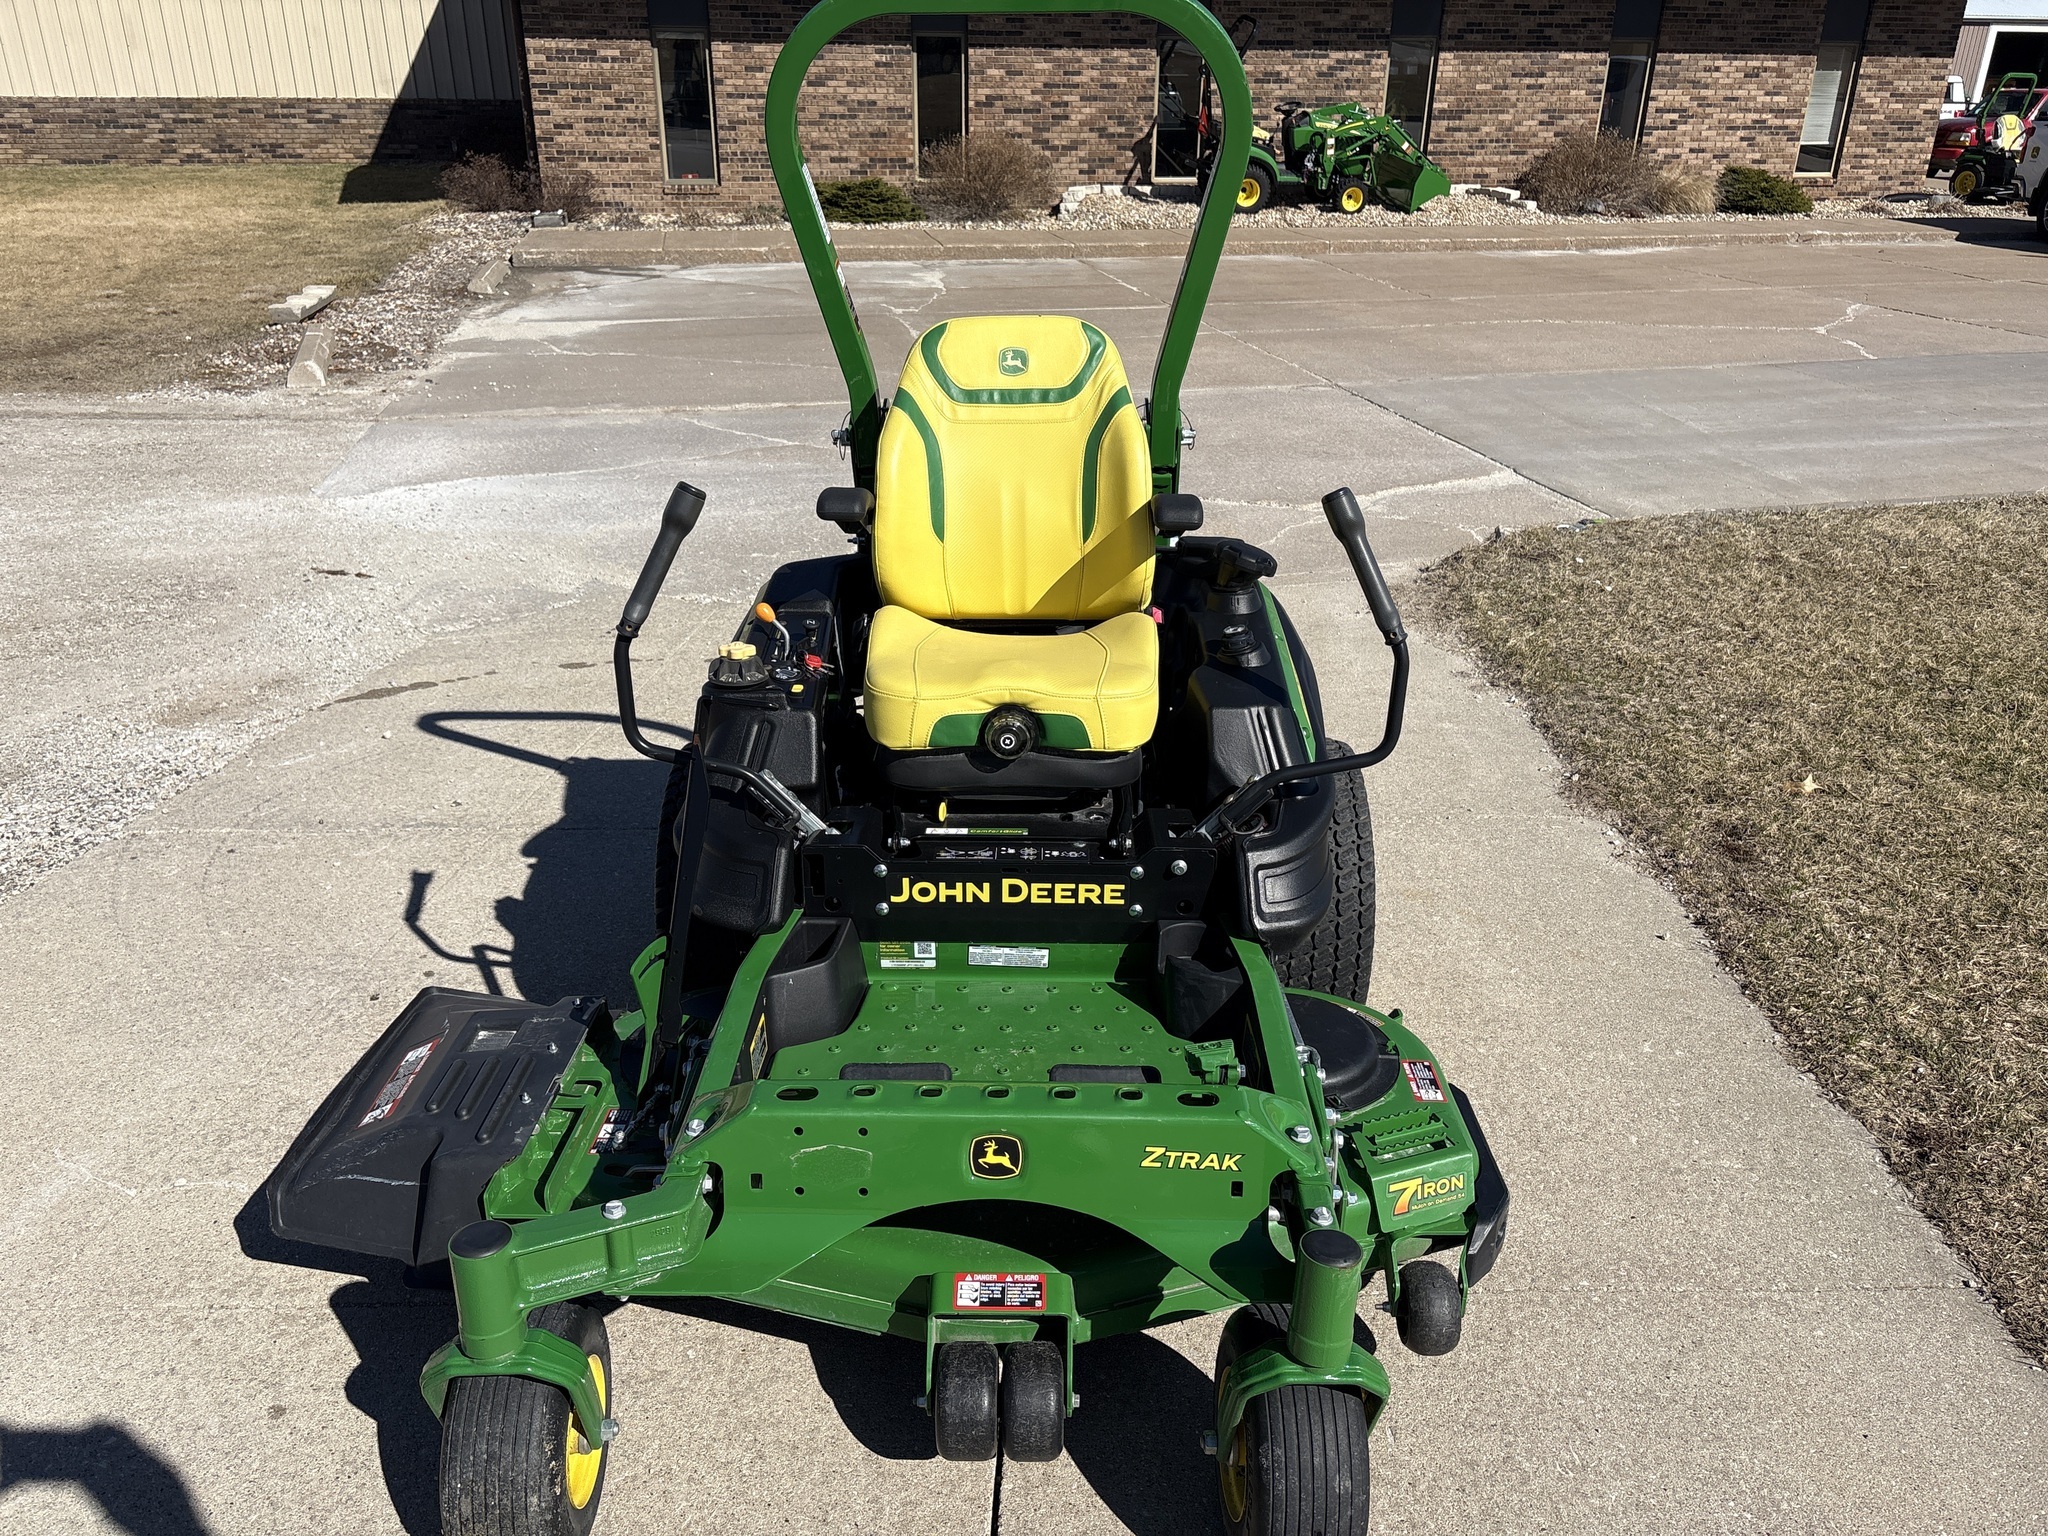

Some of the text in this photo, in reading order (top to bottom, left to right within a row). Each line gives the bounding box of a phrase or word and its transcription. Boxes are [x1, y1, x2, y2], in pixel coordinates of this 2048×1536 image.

[890, 877, 1126, 905] JOHN DEERE
[1140, 1146, 1246, 1172] ZTRAK
[1411, 1202, 1427, 1211] Mulch
[1435, 1195, 1457, 1205] Demand
